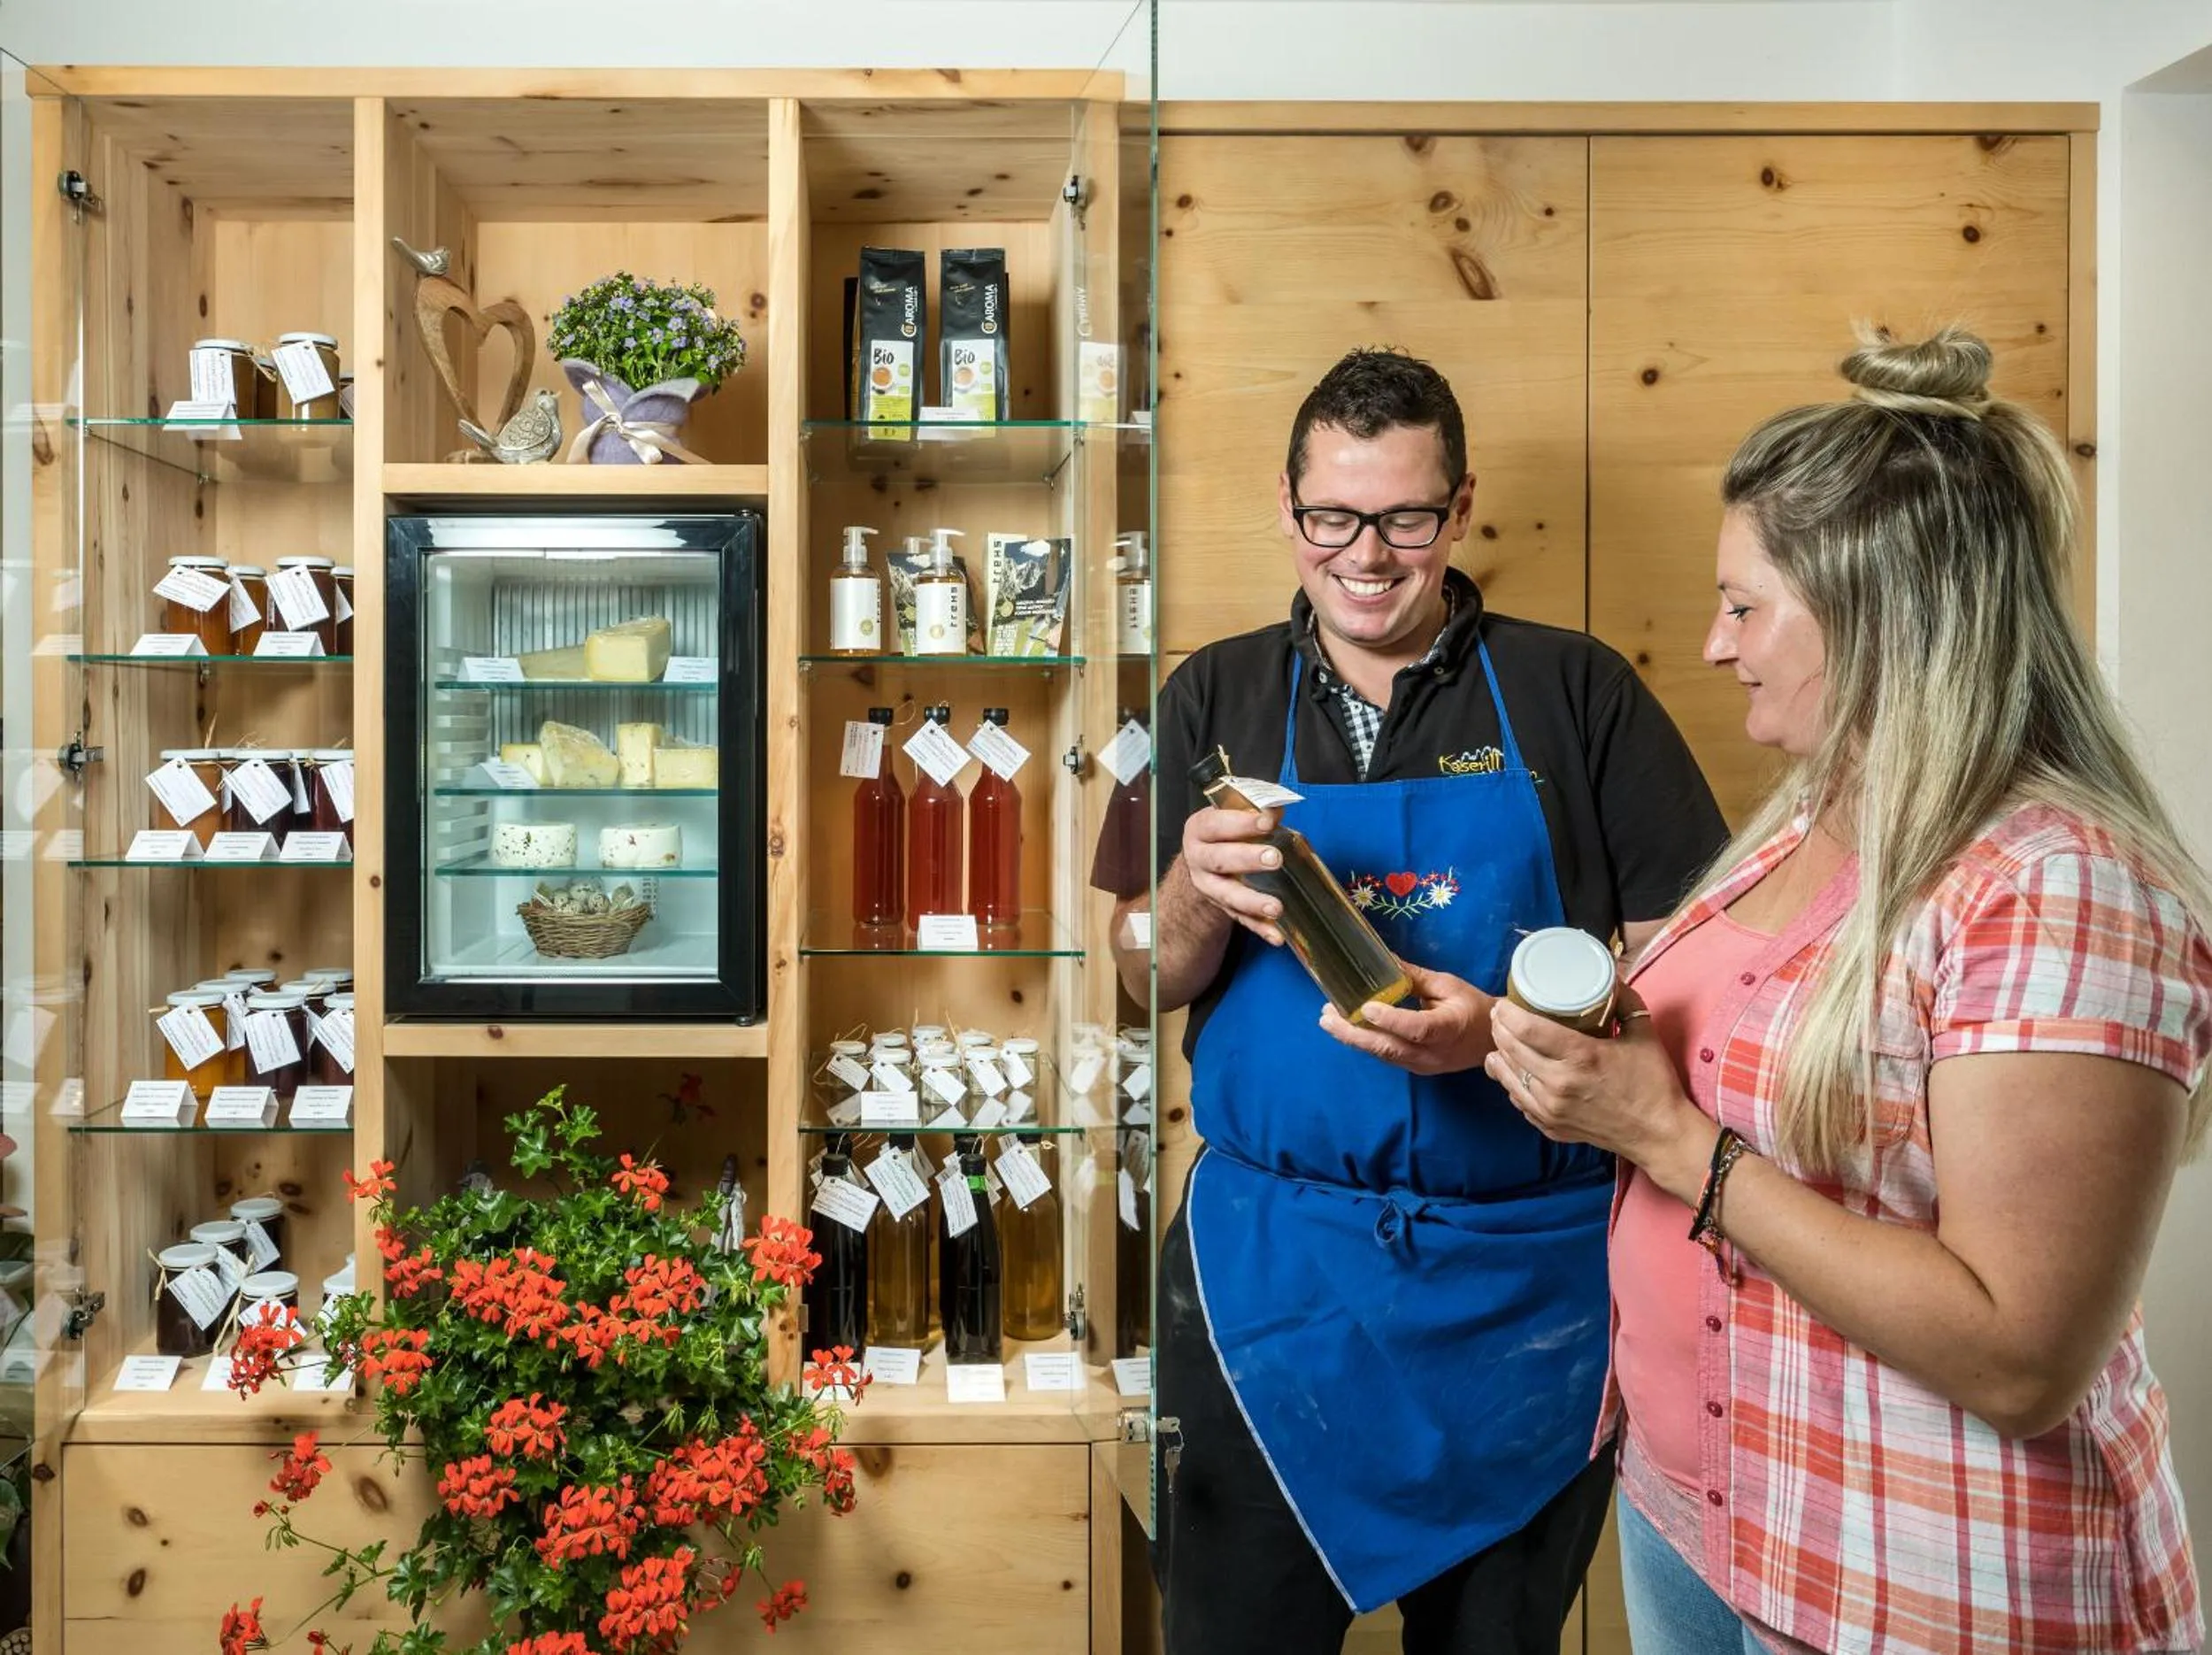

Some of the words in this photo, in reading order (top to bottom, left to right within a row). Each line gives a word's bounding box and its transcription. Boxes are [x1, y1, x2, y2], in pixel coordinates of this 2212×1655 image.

[901, 285, 917, 337] CAROMA
[981, 284, 997, 334] CAROMA
[874, 348, 895, 365] Bio
[955, 349, 976, 365] Bio
[1439, 752, 1501, 773] Kaserill
